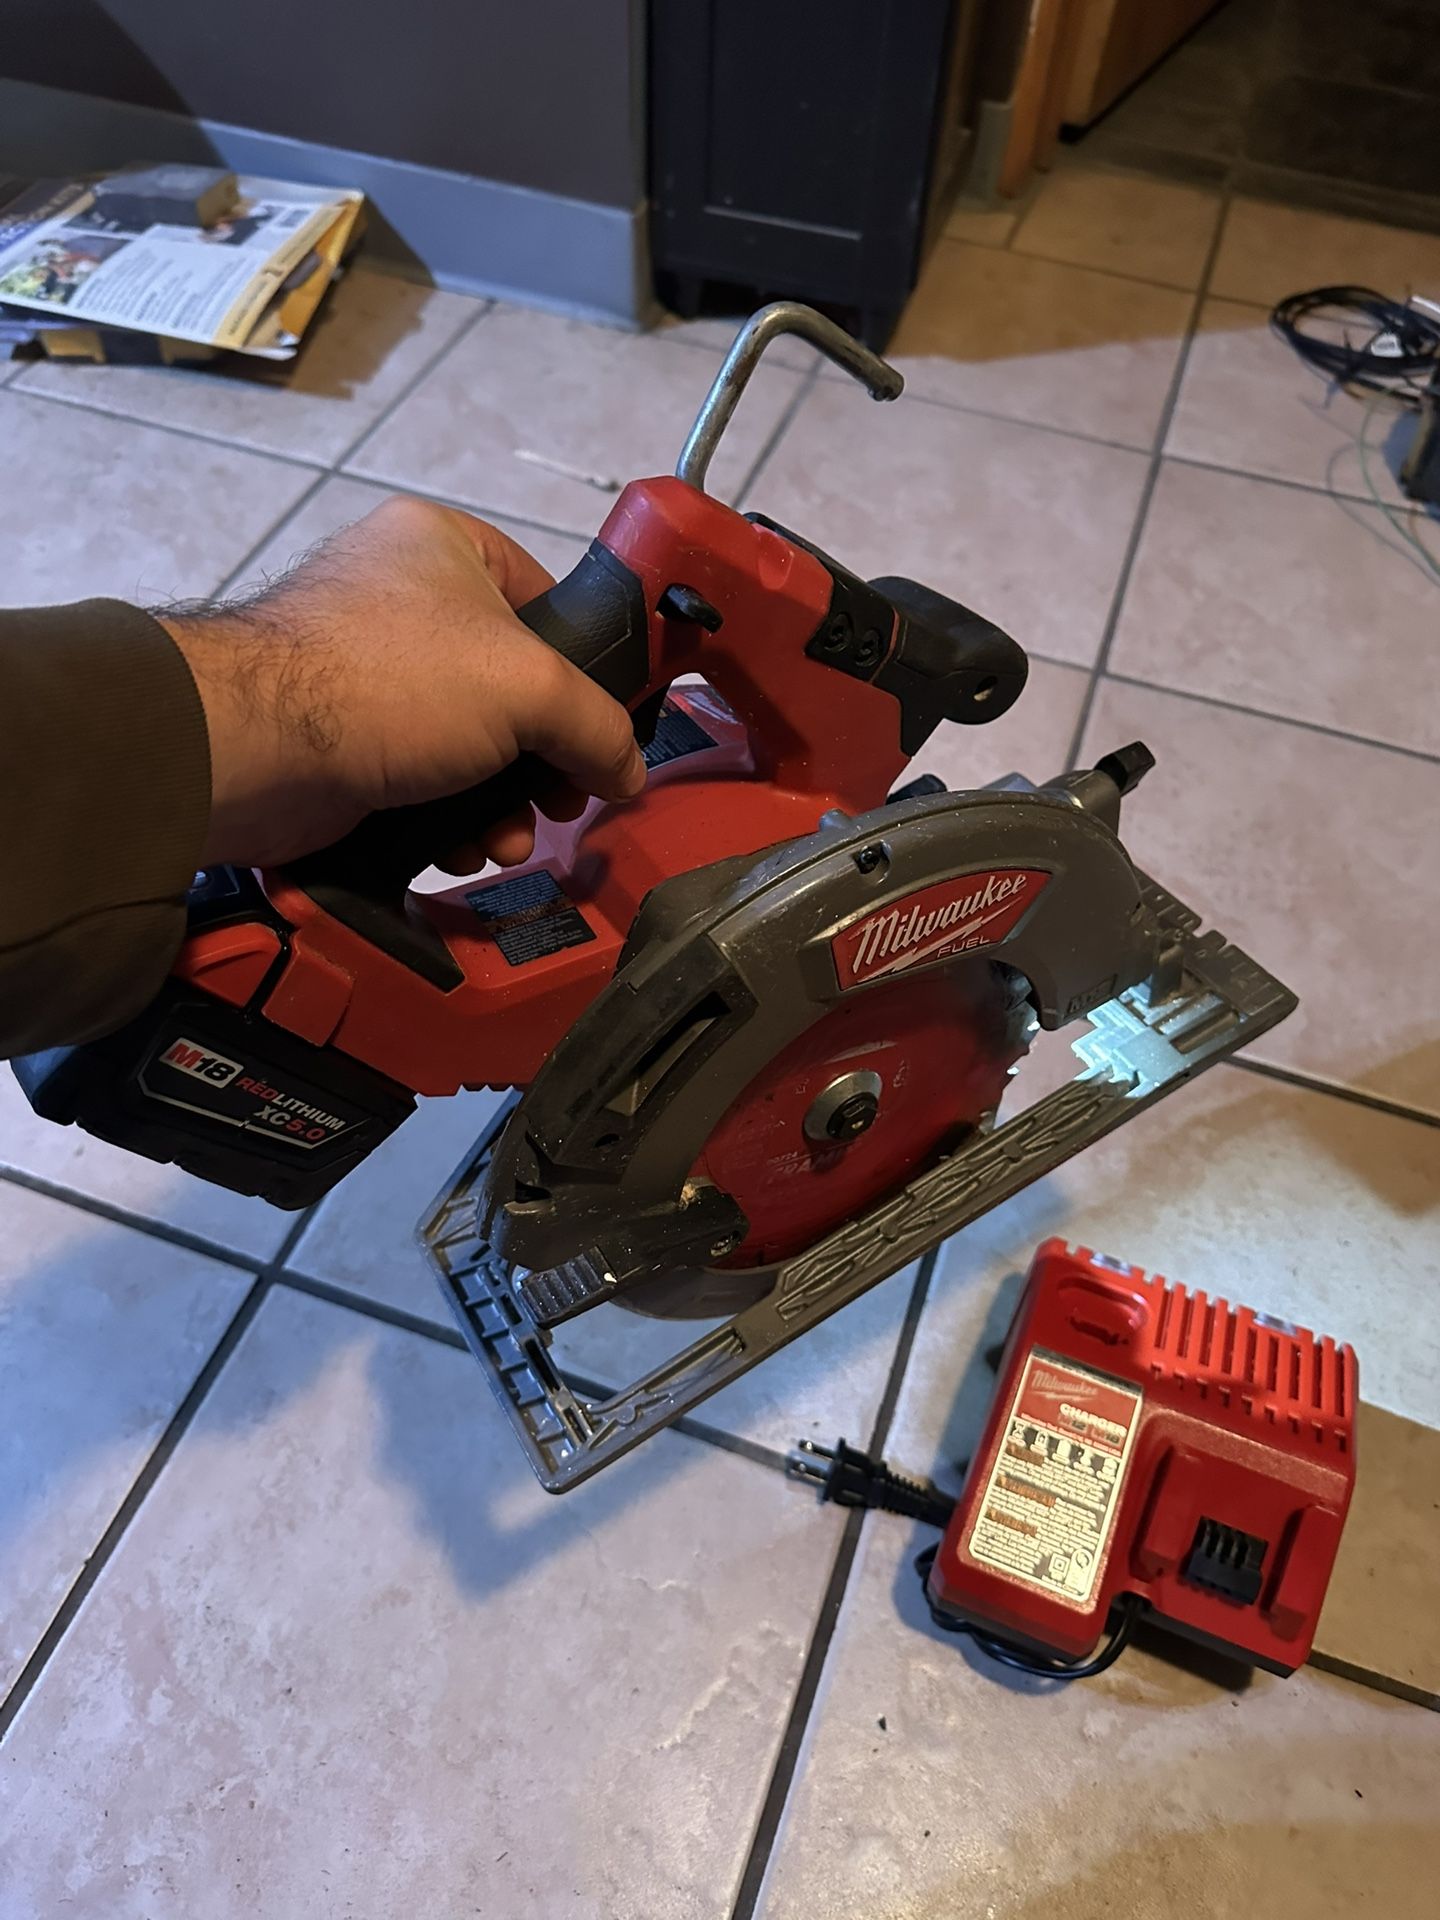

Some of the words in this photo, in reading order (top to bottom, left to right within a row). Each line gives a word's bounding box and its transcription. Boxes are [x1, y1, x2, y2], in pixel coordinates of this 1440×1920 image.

[849, 873, 1027, 974] Milwaukee
[936, 934, 991, 958] FUEL
[167, 1042, 236, 1082] M18
[253, 1104, 326, 1140] XC5.0
